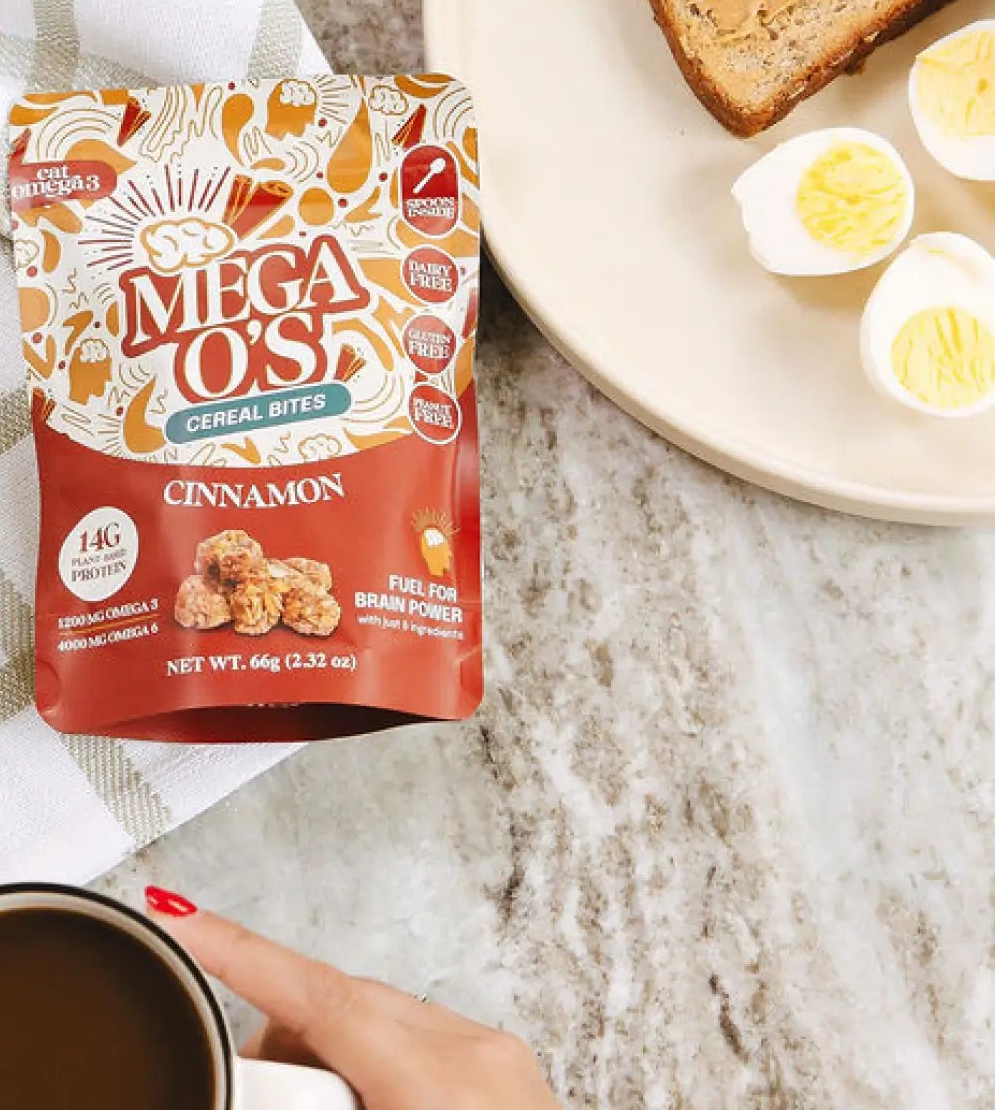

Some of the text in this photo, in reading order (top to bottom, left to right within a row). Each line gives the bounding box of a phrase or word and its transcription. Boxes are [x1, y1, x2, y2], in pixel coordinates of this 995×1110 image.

[36, 165, 70, 180] eat
[408, 260, 452, 278] DAIRY
[125, 239, 364, 350] MEGA
[409, 273, 453, 292] FREE
[183, 311, 319, 399] O'S
[408, 341, 451, 360] FREE
[186, 394, 326, 432] CEREAL BITES
[414, 409, 454, 429] FREE
[163, 472, 346, 508] CINNAMON
[79, 521, 120, 552] 14G
[71, 560, 127, 582] PROTEIN
[389, 574, 457, 603] FUEL FOR
[105, 601, 149, 621] OMEGA
[354, 591, 463, 623] BRAIN POWER
[107, 625, 149, 644] OMEGA
[150, 621, 159, 633] 6
[166, 652, 358, 677] NET WT. 66g (2.32 oz)
